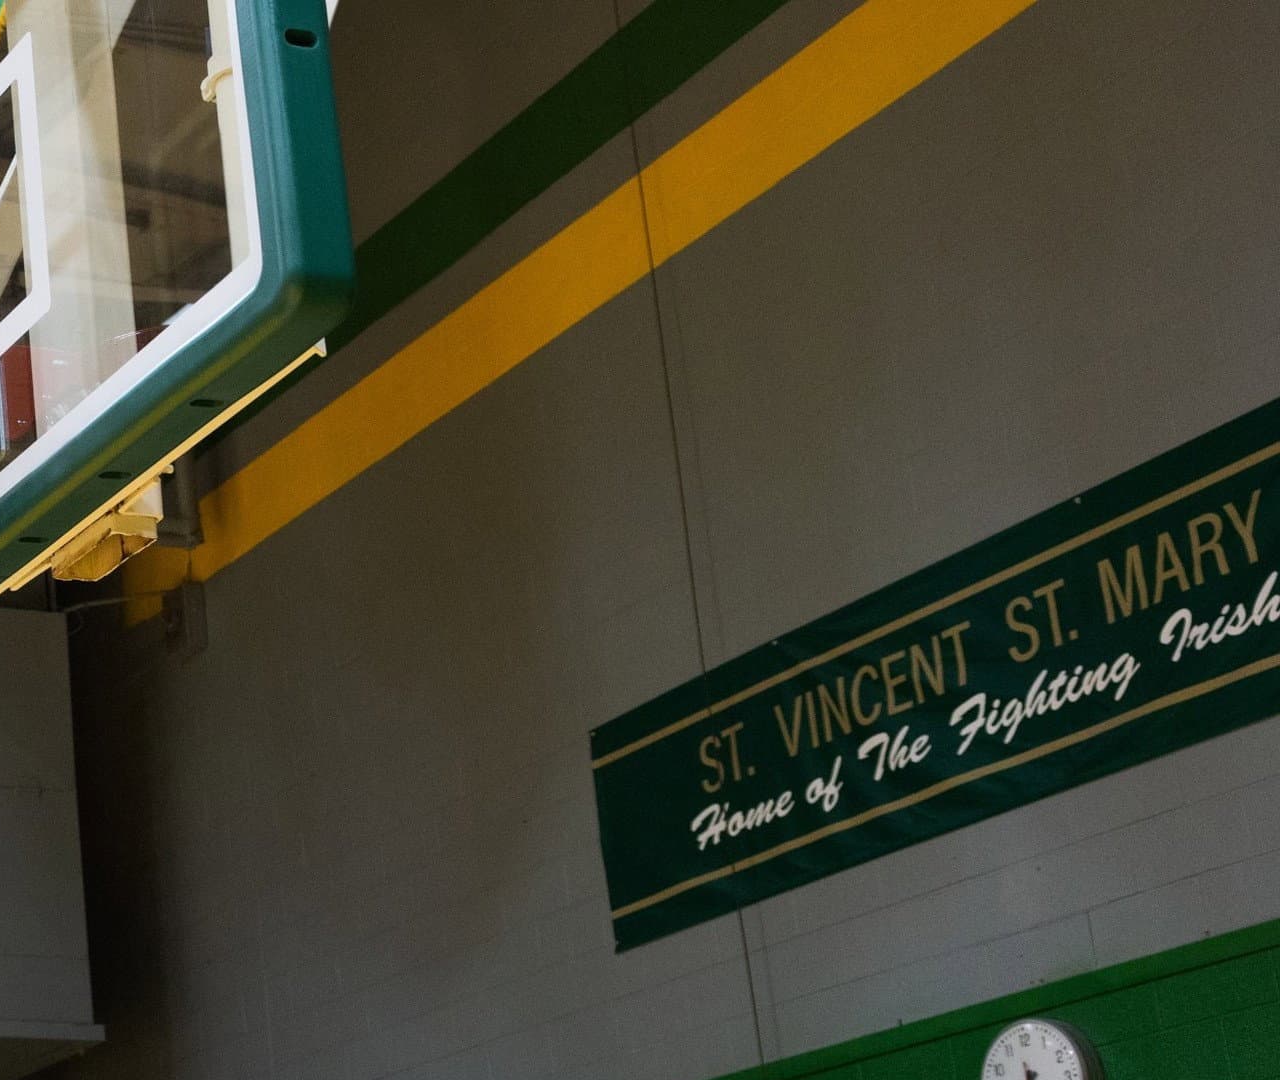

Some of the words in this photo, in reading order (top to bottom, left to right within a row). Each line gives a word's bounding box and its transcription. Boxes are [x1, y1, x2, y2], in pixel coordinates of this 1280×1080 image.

[690, 788, 795, 850] Home
[804, 757, 844, 813] of
[858, 731, 932, 781] The
[949, 651, 1142, 756] Fighting
[1159, 571, 1280, 663] Irish
[699, 722, 755, 794] ST.
[774, 621, 973, 757] VINCENT
[1004, 578, 1078, 664] ST.
[1096, 490, 1263, 626] MARY
